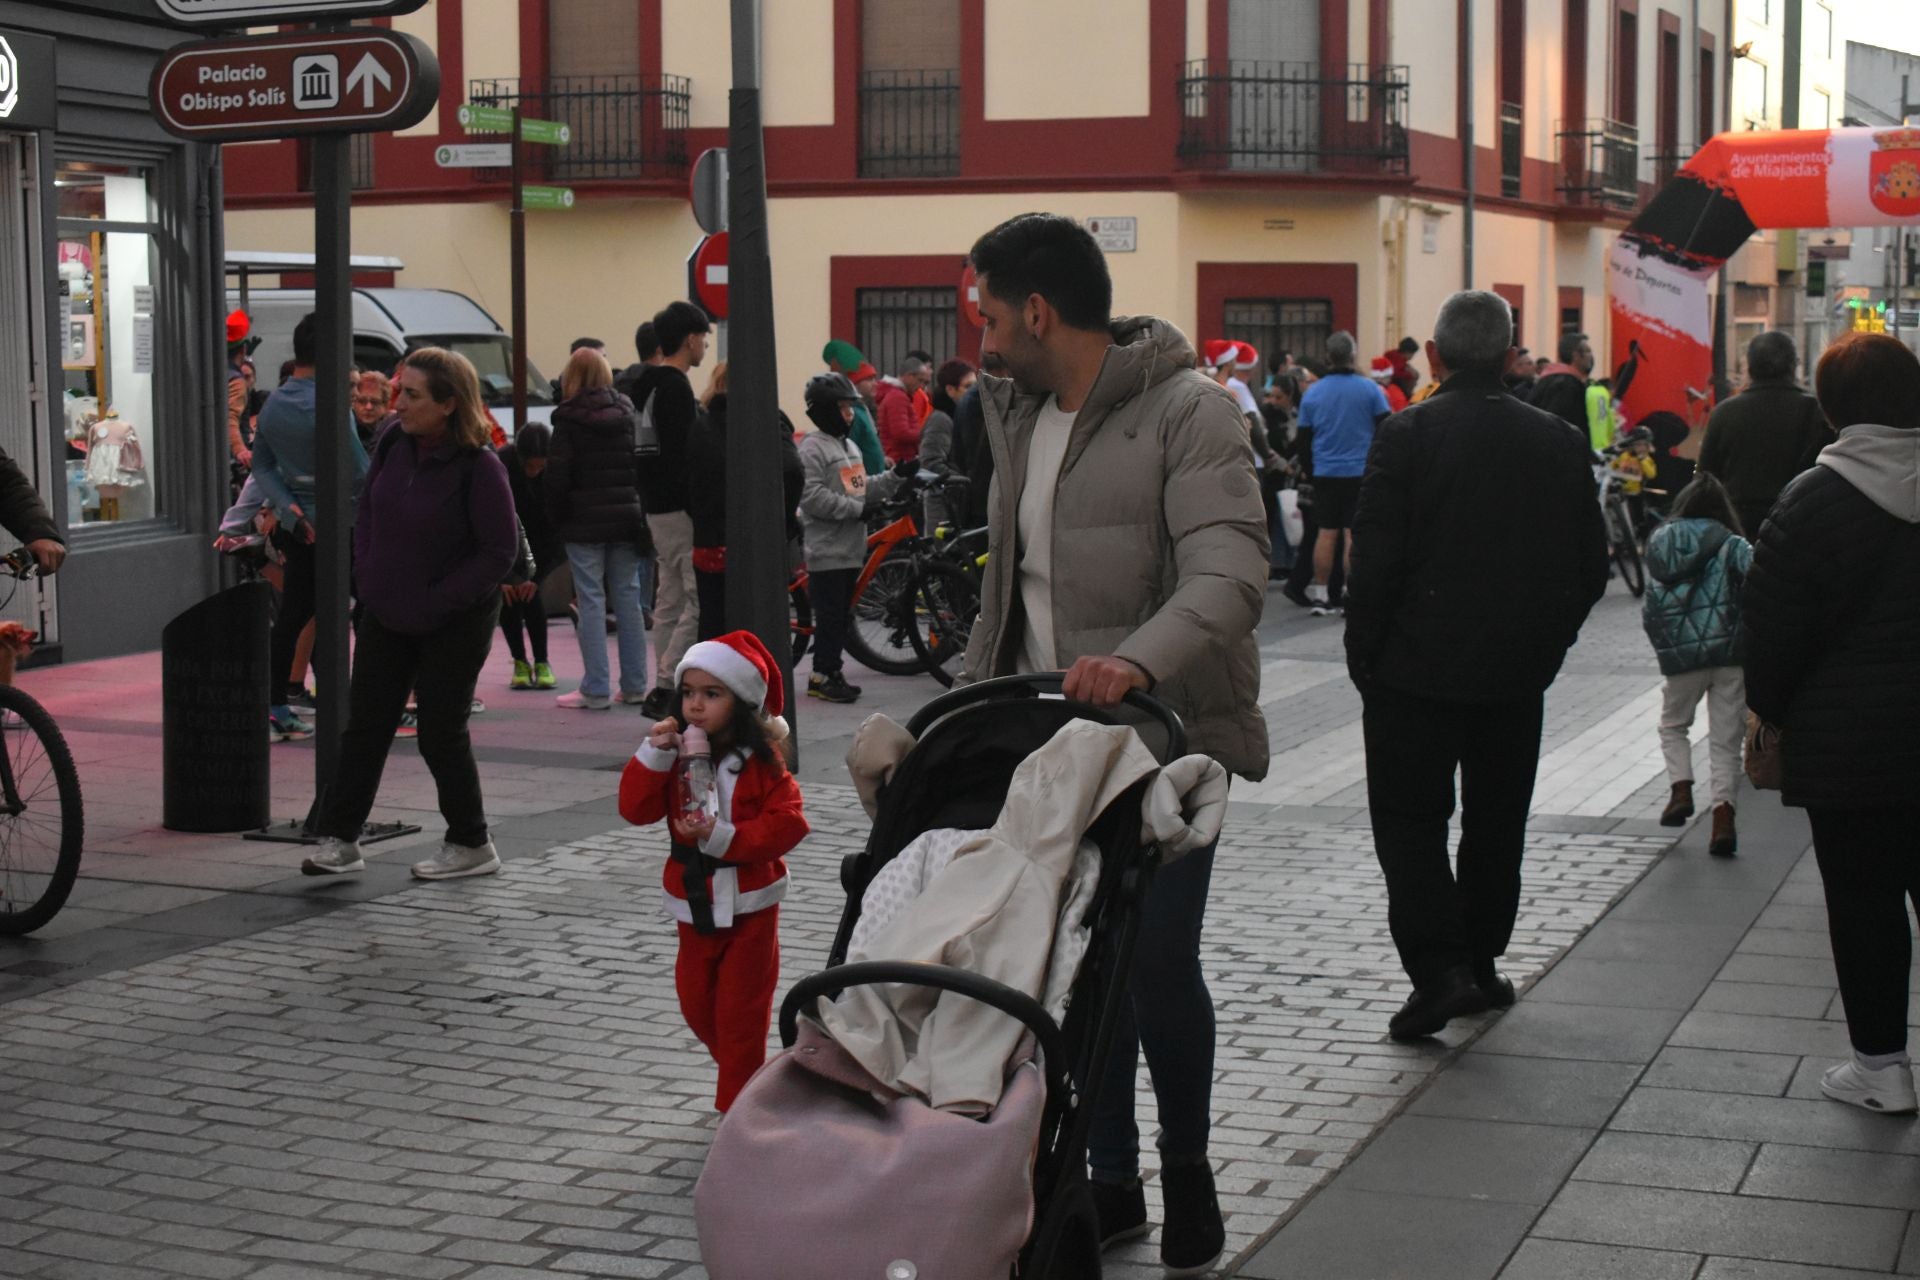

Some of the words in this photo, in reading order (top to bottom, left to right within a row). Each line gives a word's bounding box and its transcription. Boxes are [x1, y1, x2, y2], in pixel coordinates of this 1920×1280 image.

[198, 63, 267, 84] Palacio
[179, 92, 243, 112] Obispo
[248, 87, 286, 107] Solís
[1731, 152, 1825, 166] Ayuntamiento
[1731, 163, 1751, 178] de
[1753, 162, 1820, 180] Miajadas
